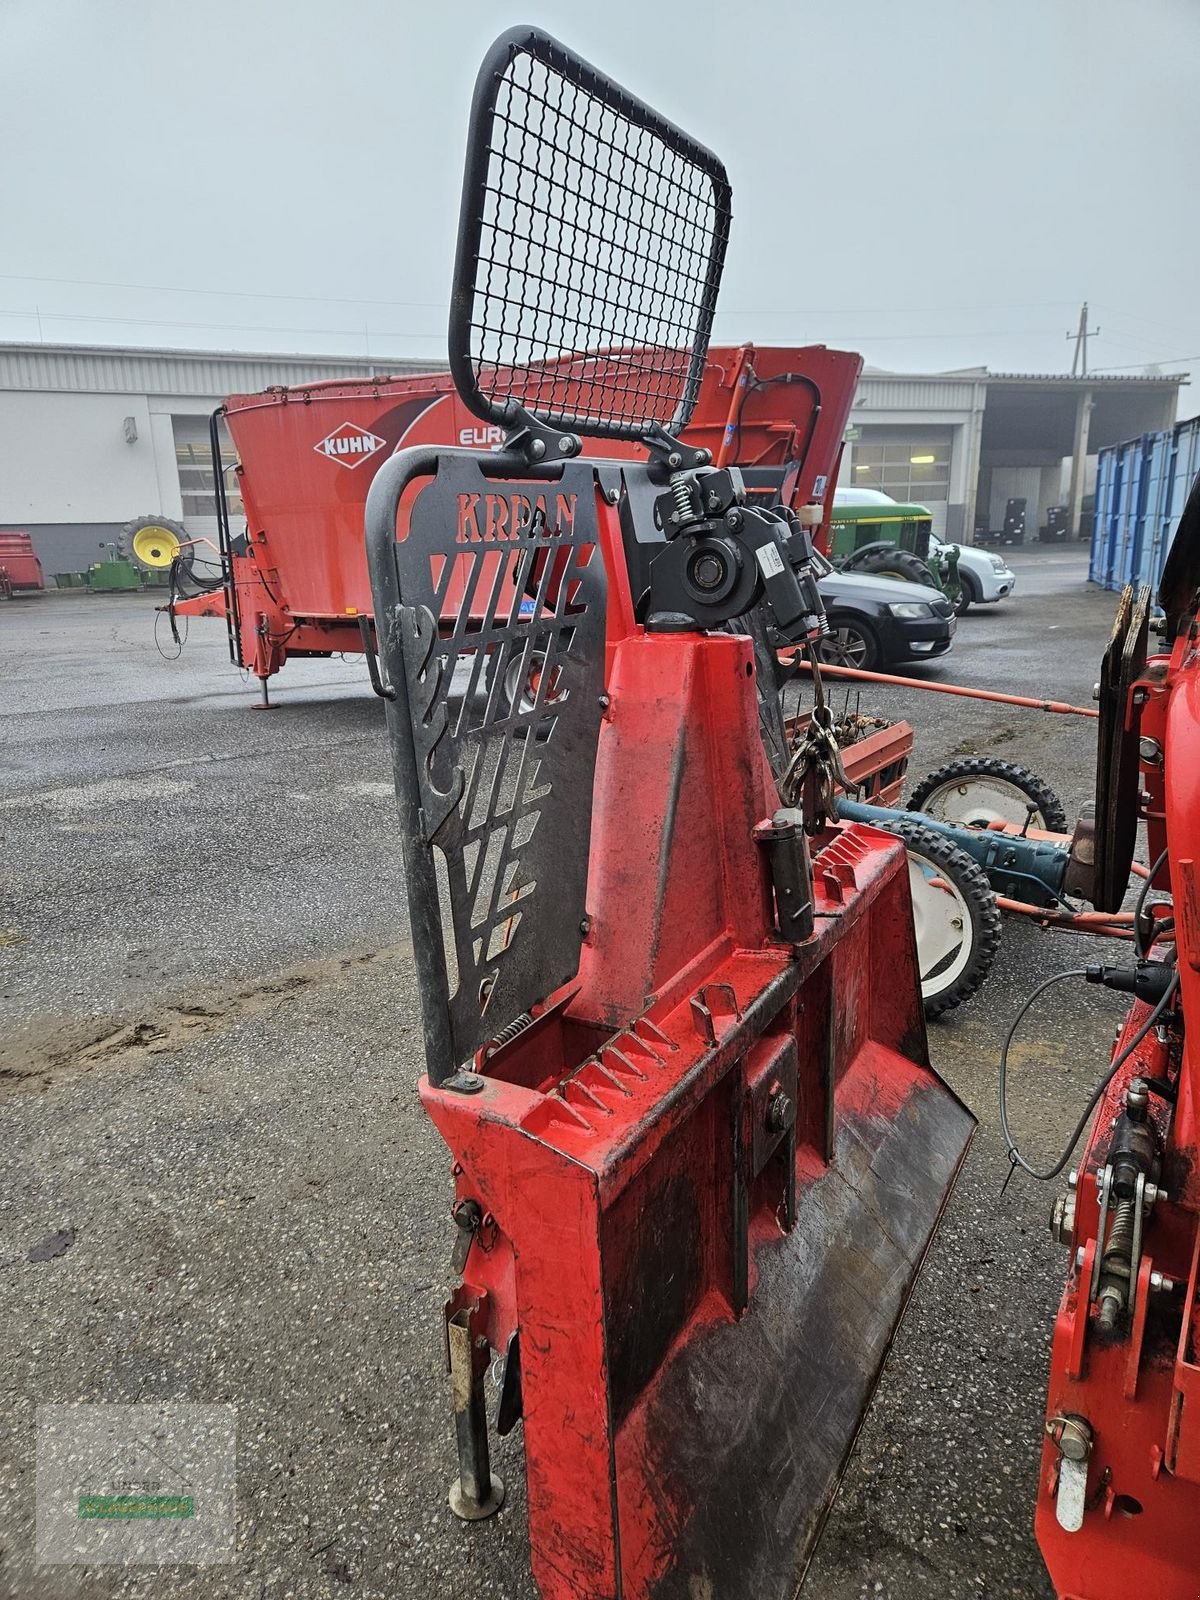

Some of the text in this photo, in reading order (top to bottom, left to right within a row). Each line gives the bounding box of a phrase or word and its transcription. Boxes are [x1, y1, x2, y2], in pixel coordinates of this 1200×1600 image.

[324, 435, 376, 455] KUHN
[460, 426, 507, 445] EUR
[456, 493, 577, 543] KRPAN
